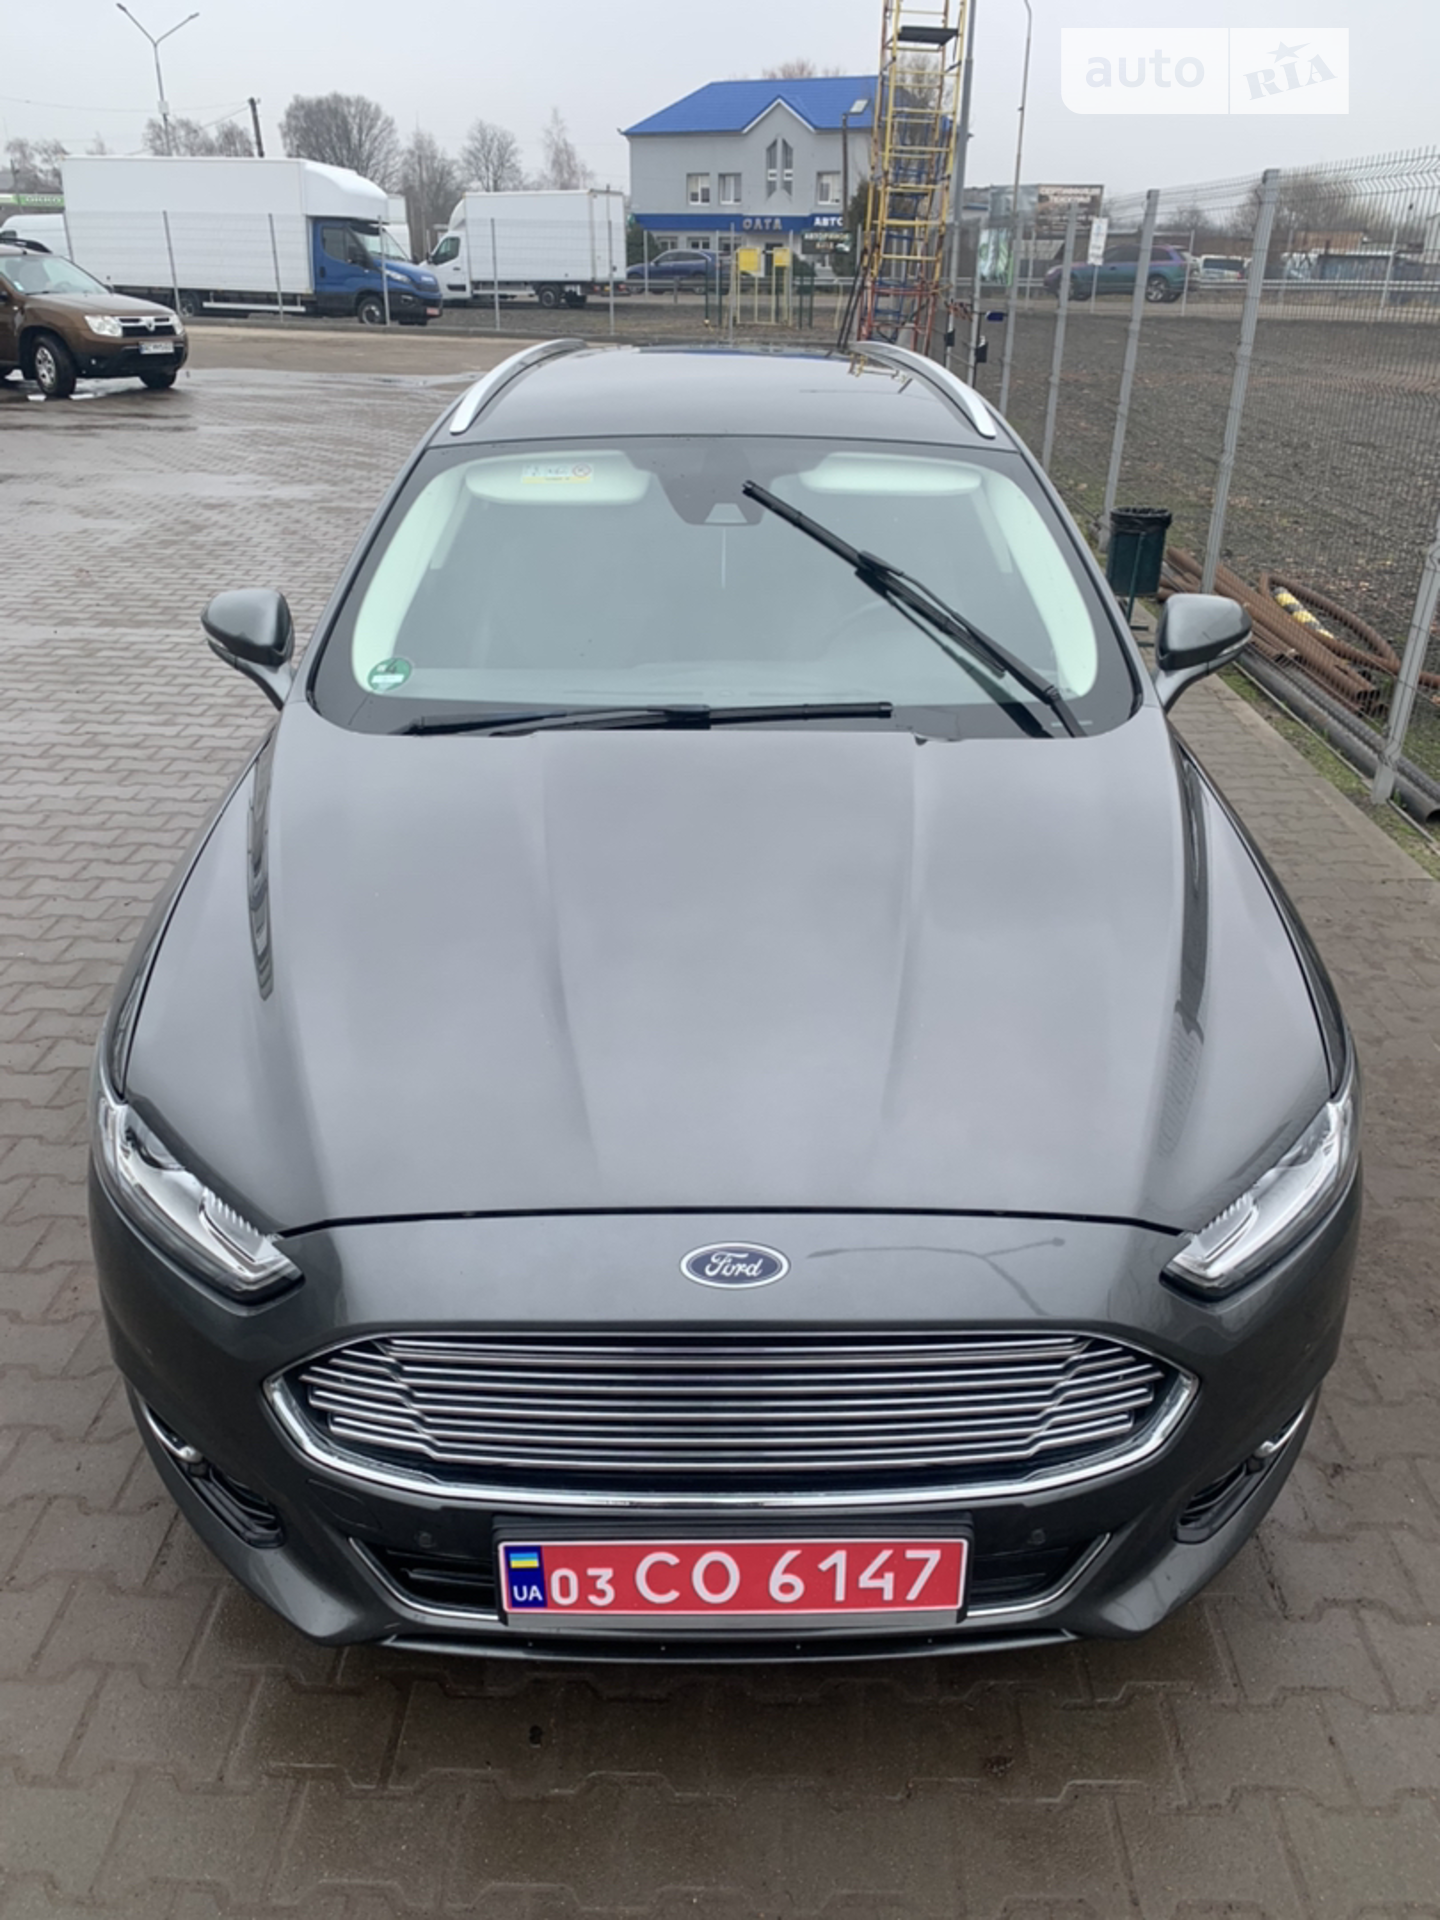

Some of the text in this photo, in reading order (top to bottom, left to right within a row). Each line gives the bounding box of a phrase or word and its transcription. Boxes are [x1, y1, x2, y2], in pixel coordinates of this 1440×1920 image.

[705, 1251, 763, 1277] Ford
[550, 1549, 943, 1607] 03 CO 6147
[513, 1585, 543, 1602] UA
